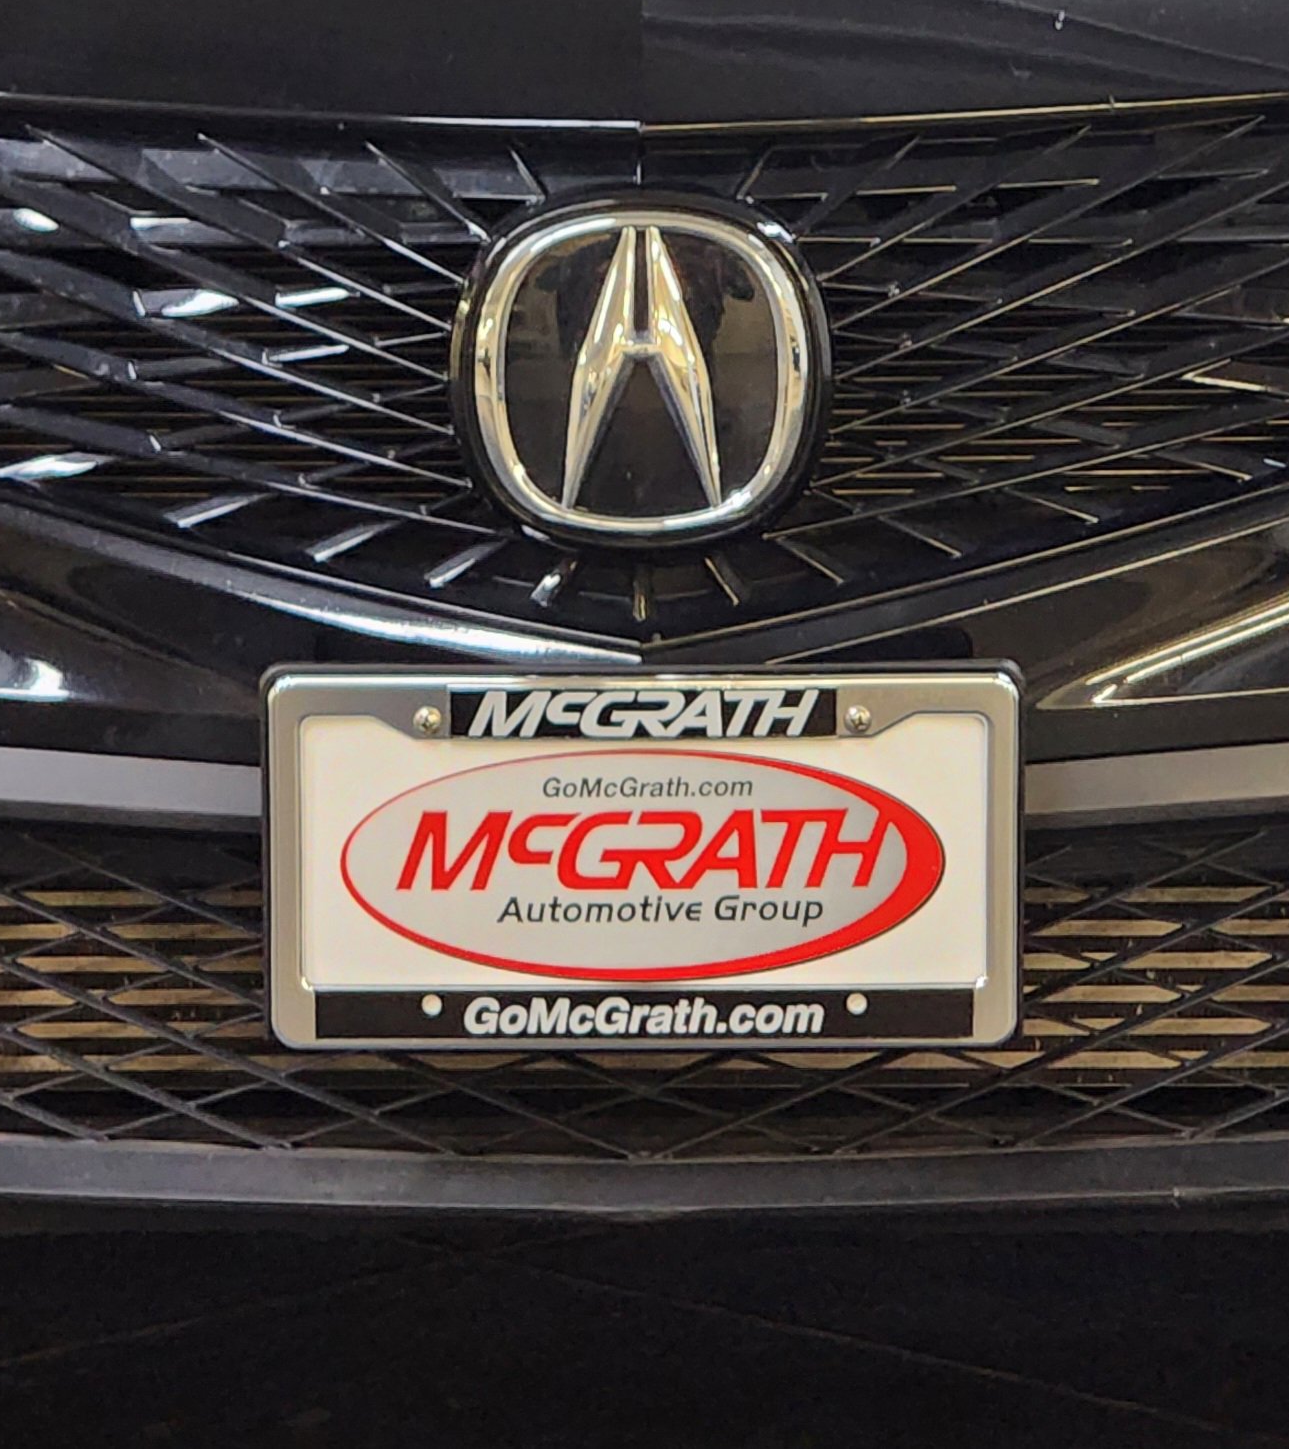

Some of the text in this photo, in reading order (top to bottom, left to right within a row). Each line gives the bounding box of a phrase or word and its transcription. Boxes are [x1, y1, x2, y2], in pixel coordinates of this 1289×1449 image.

[541, 776, 754, 799] GoMcGrath.com
[496, 894, 824, 929] Automotive Group
[462, 995, 825, 1037] GoMcGrath.com
